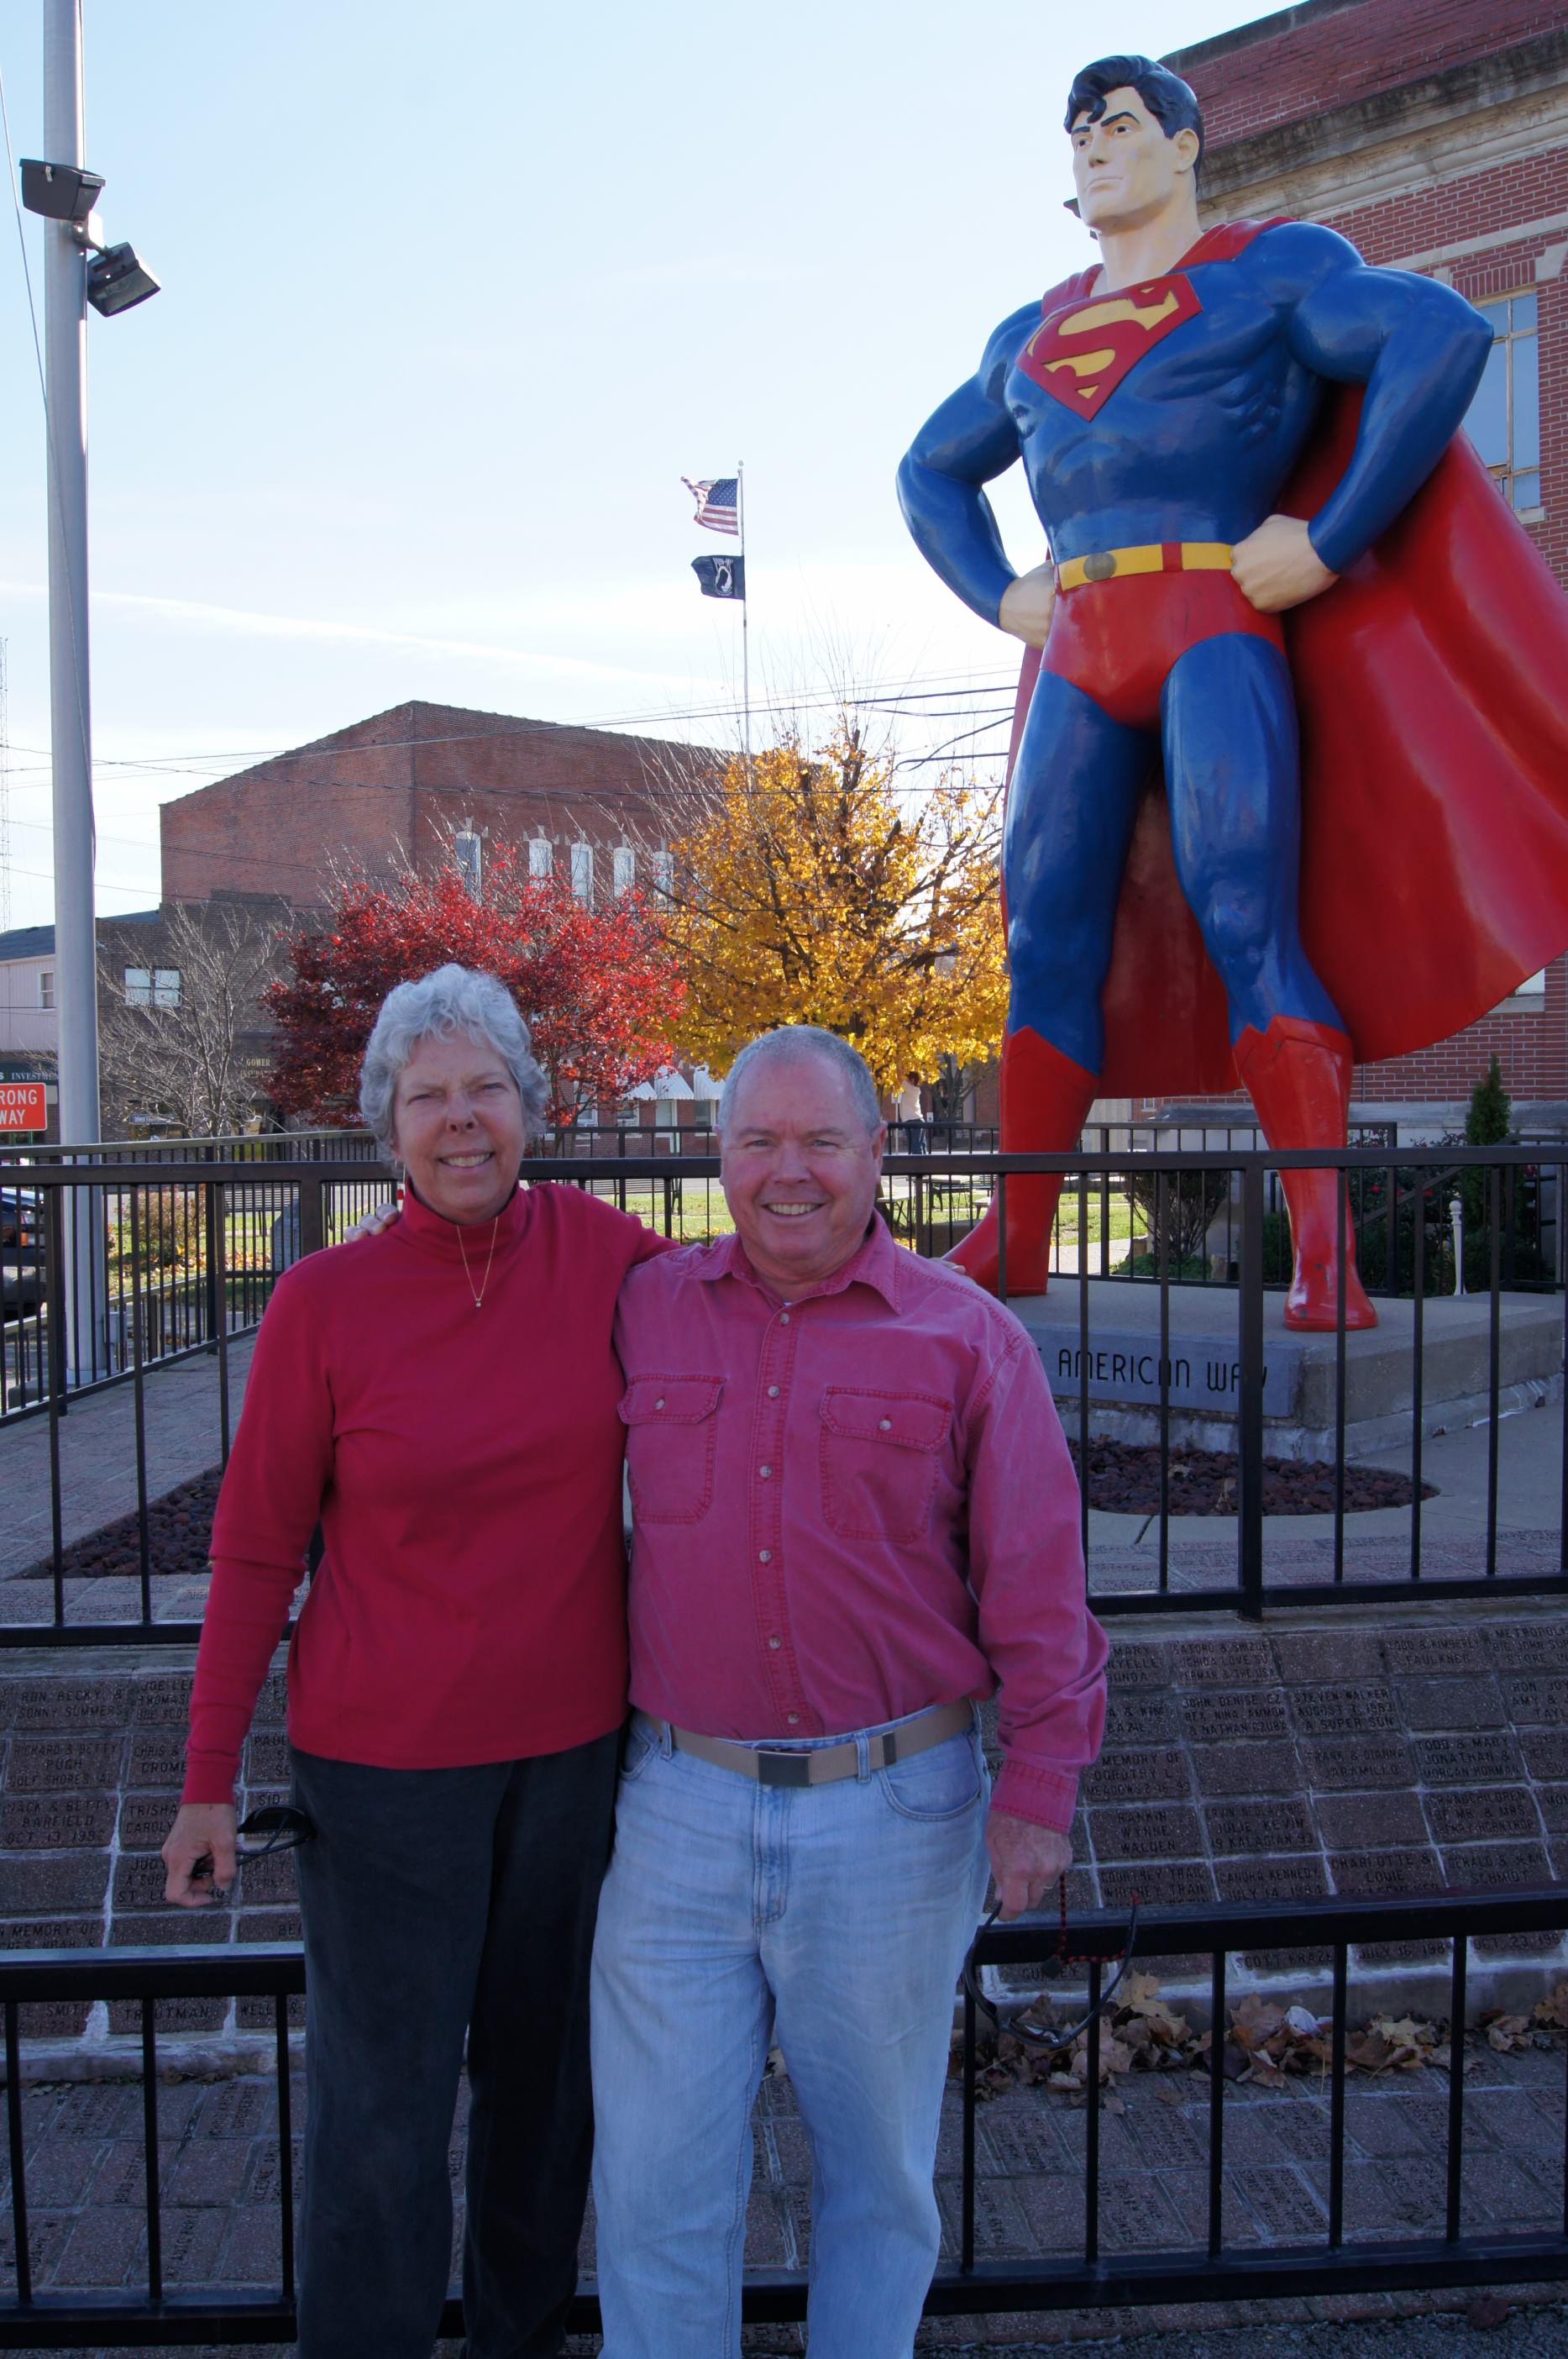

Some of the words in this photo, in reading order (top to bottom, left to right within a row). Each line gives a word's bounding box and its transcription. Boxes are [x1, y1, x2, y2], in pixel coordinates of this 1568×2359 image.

[246, 1058, 270, 1067] GOWER
[1518, 1640, 1544, 1652] JOHN
[1223, 1654, 1251, 1665] LOVE
[1406, 1653, 1471, 1666] FAULKNER
[1506, 1652, 1548, 1665] STORE
[1234, 1668, 1252, 1679] THE
[141, 1681, 165, 1692] JOE
[1512, 1681, 1537, 1693] RON
[21, 1691, 47, 1702] RON
[57, 1689, 102, 1701] BECKY
[1219, 1694, 1258, 1708] DENISE
[1294, 1692, 1340, 1703] STEVEN
[1345, 1689, 1388, 1700] WALKER
[1512, 1694, 1539, 1706] AMY
[18, 1707, 57, 1719] SONNY
[66, 1705, 123, 1717] SUMMERS
[1204, 1723, 1249, 1736] NATHAN
[1305, 1721, 1314, 1731] A
[1319, 1718, 1361, 1731] SUPER
[13, 1744, 60, 1757] RICHARD
[80, 1742, 118, 1755] BETTY
[1416, 1739, 1450, 1751] TODD
[1472, 1736, 1509, 1748] MARY
[134, 1746, 165, 1757] CHRIS
[46, 1759, 82, 1771] PUGH
[1102, 1753, 1157, 1766] MEMORY
[1166, 1752, 1182, 1763] OF
[1425, 1752, 1495, 1766] JONATHAN
[45, 1773, 90, 1786] SHORES
[1093, 1768, 1156, 1782] DOROTHY
[1424, 1767, 1470, 1779] MORGAN
[1087, 1784, 1141, 1796] MEADOWS
[258, 1793, 281, 1806] SID
[8, 1801, 42, 1814] JACK
[66, 1799, 111, 1812] BETTY
[1456, 1809, 1474, 1820] MR
[1499, 1805, 1526, 1817] MRS
[23, 1815, 95, 1829] BARFIELD
[1263, 1818, 1305, 1831] KEVIN
[7, 1831, 34, 1845] OCT
[1121, 1825, 1170, 1838] WYNNE
[1121, 1840, 1176, 1854] WALDEN
[1330, 1853, 1413, 1870] CHARLOTTE
[1421, 1852, 1433, 1864] &
[1268, 1867, 1319, 1883] KENNEDY
[1471, 1869, 1531, 1886] SCHMIDT
[117, 1892, 135, 1904] ST
[1227, 1887, 1257, 1901] JULY
[12, 1924, 71, 1937] MEMORY
[80, 1922, 97, 1935] OF
[124, 2005, 209, 2020] TRUTMAN
